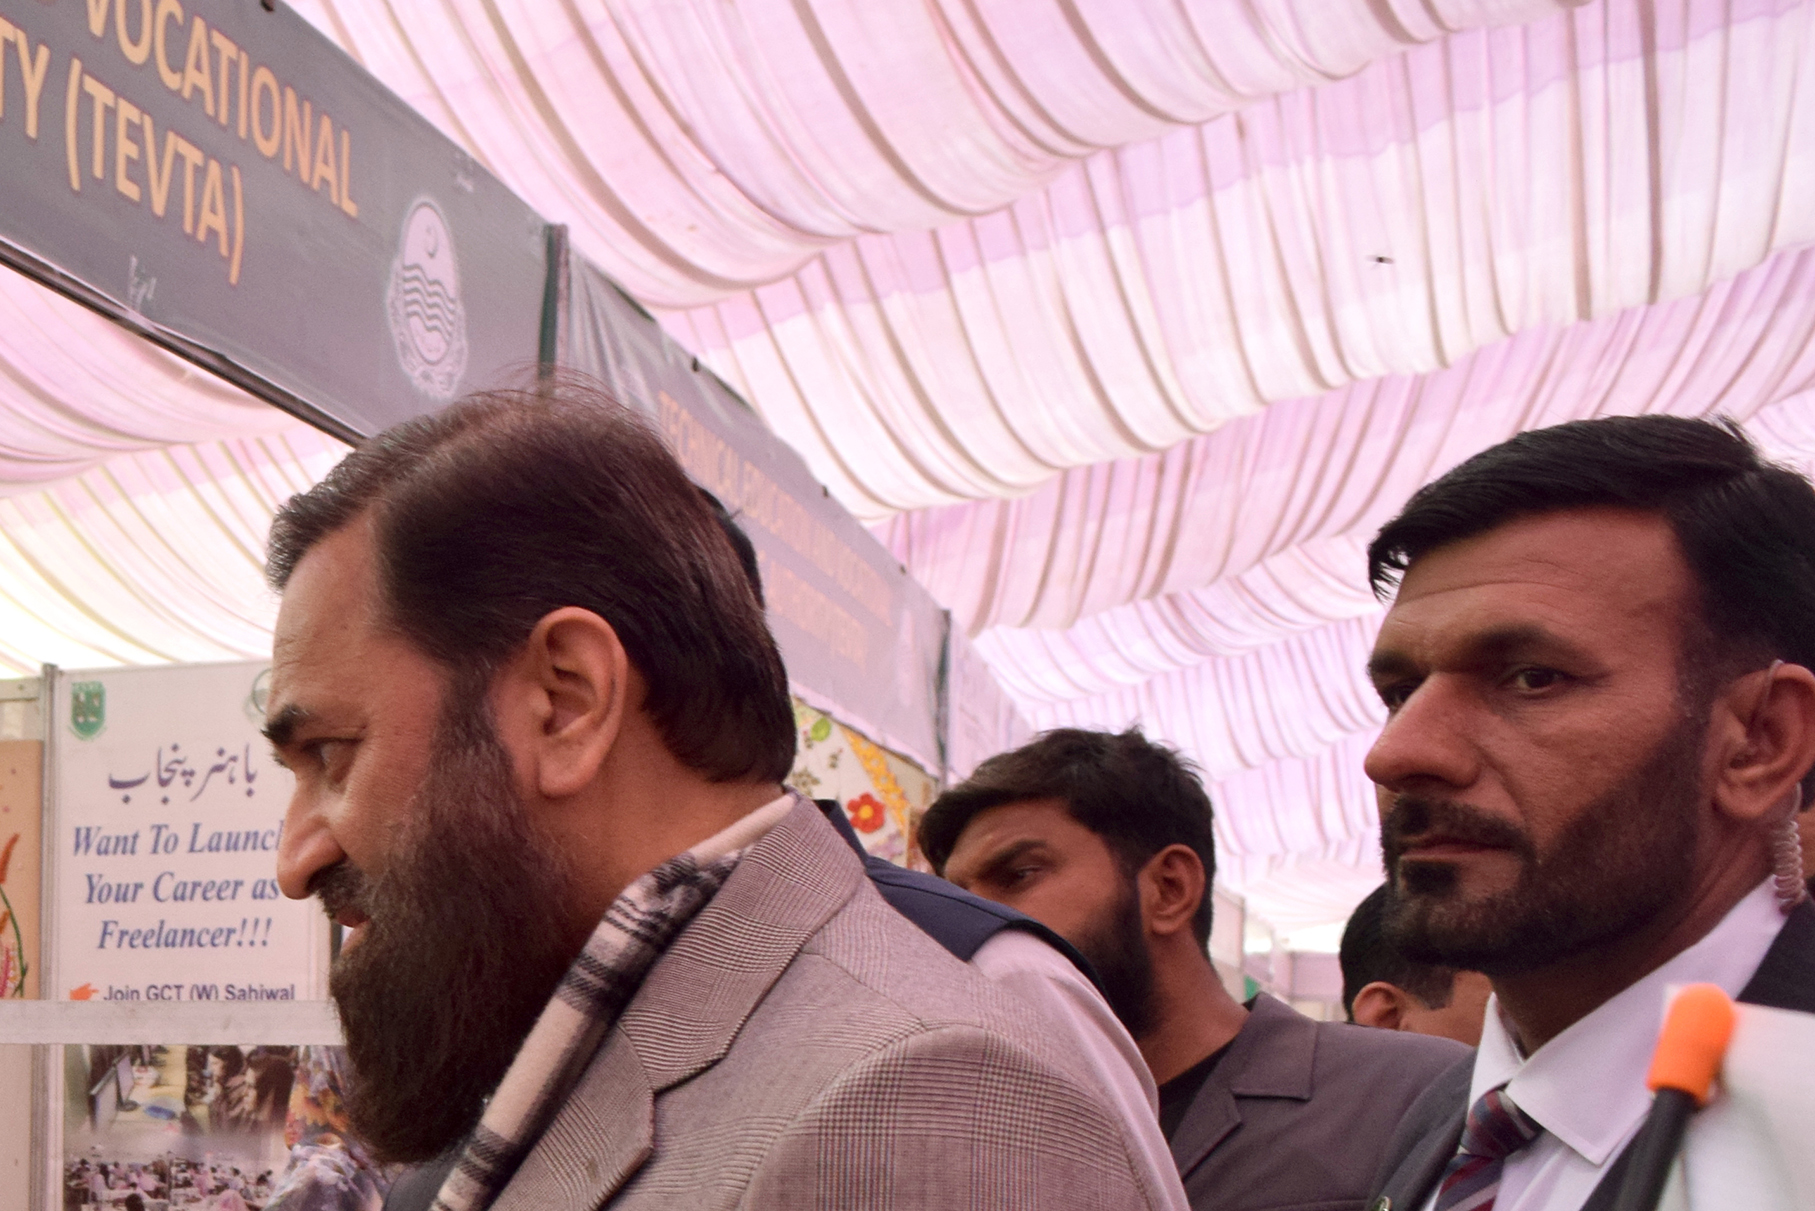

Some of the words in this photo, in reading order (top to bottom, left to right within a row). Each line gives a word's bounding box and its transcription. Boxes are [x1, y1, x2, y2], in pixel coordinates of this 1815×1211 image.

[65, 57, 244, 285] (TEVTA)
[108, 743, 196, 805] پنجاب
[74, 825, 140, 857] Want
[149, 823, 179, 855] To
[84, 873, 144, 905] Your
[153, 870, 244, 903] Career
[251, 877, 280, 901] as
[96, 917, 273, 950] Freelancer!!!
[103, 983, 141, 1000] Join
[145, 985, 185, 1000] GCT
[188, 984, 220, 1000] (W)
[224, 982, 296, 1000] Sahiwal
